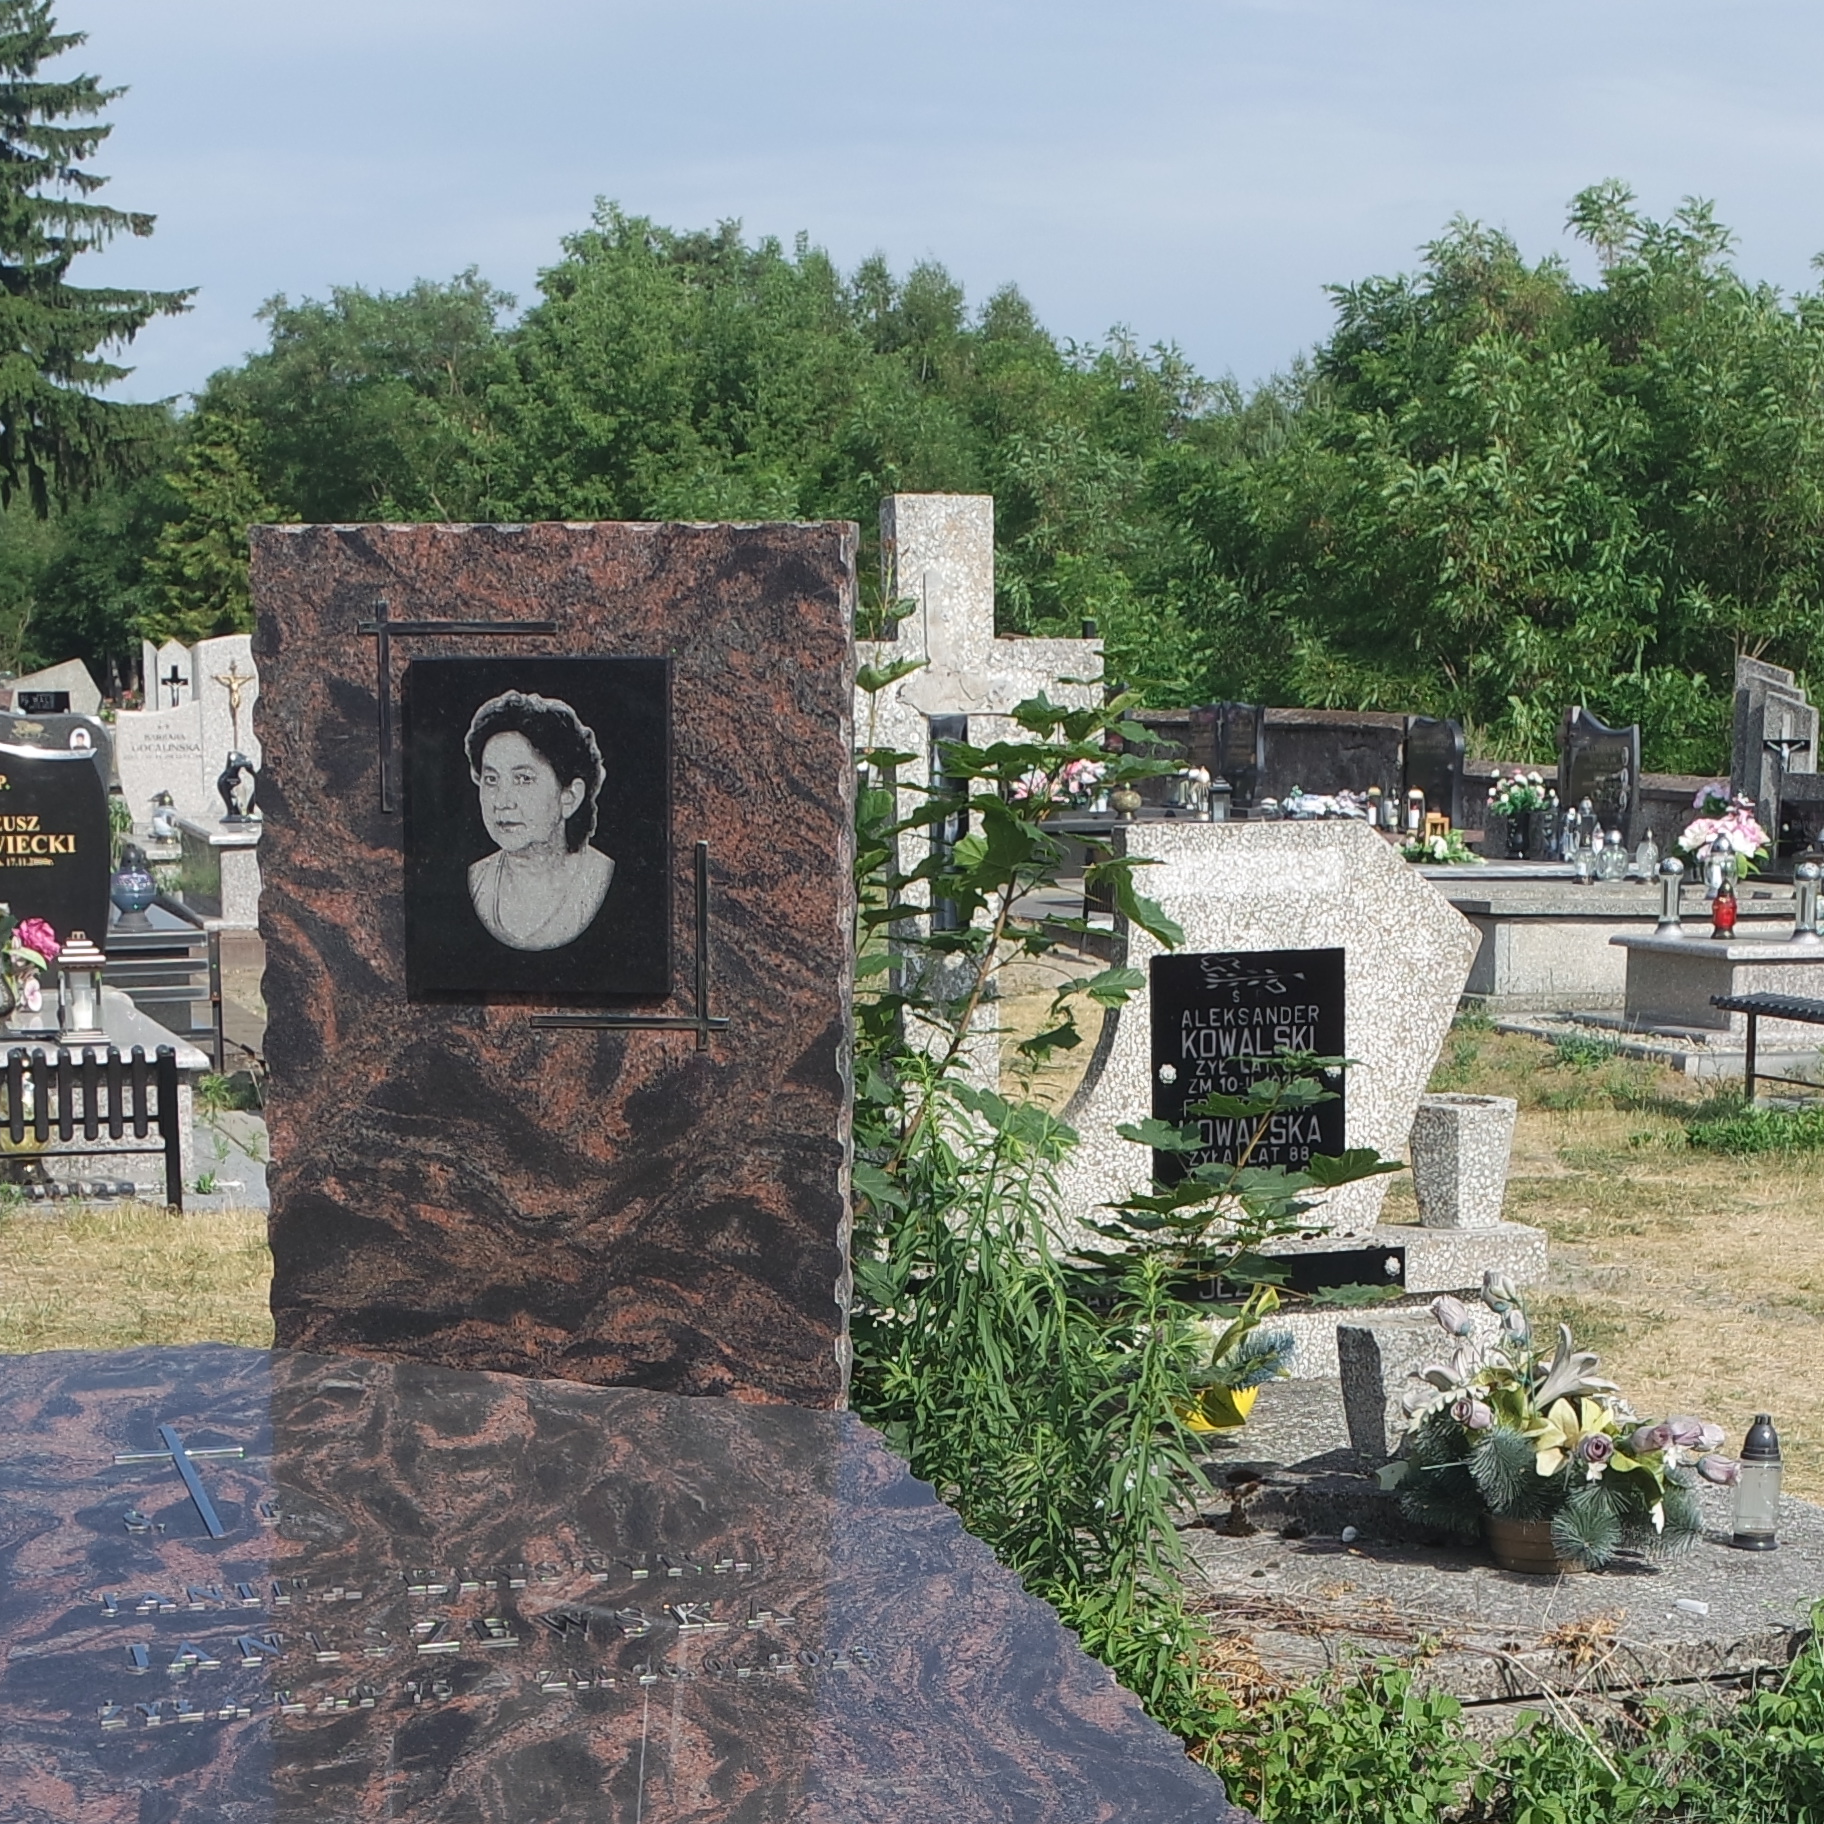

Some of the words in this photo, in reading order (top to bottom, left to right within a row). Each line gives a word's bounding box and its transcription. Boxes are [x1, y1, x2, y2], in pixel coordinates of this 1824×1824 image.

[1181, 1004, 1321, 1029] ALEKSANDER
[1181, 1025, 1315, 1060] KOWALSKI
[1179, 1115, 1322, 1147] OWALSKA
[1289, 1145, 1310, 1162] 88
